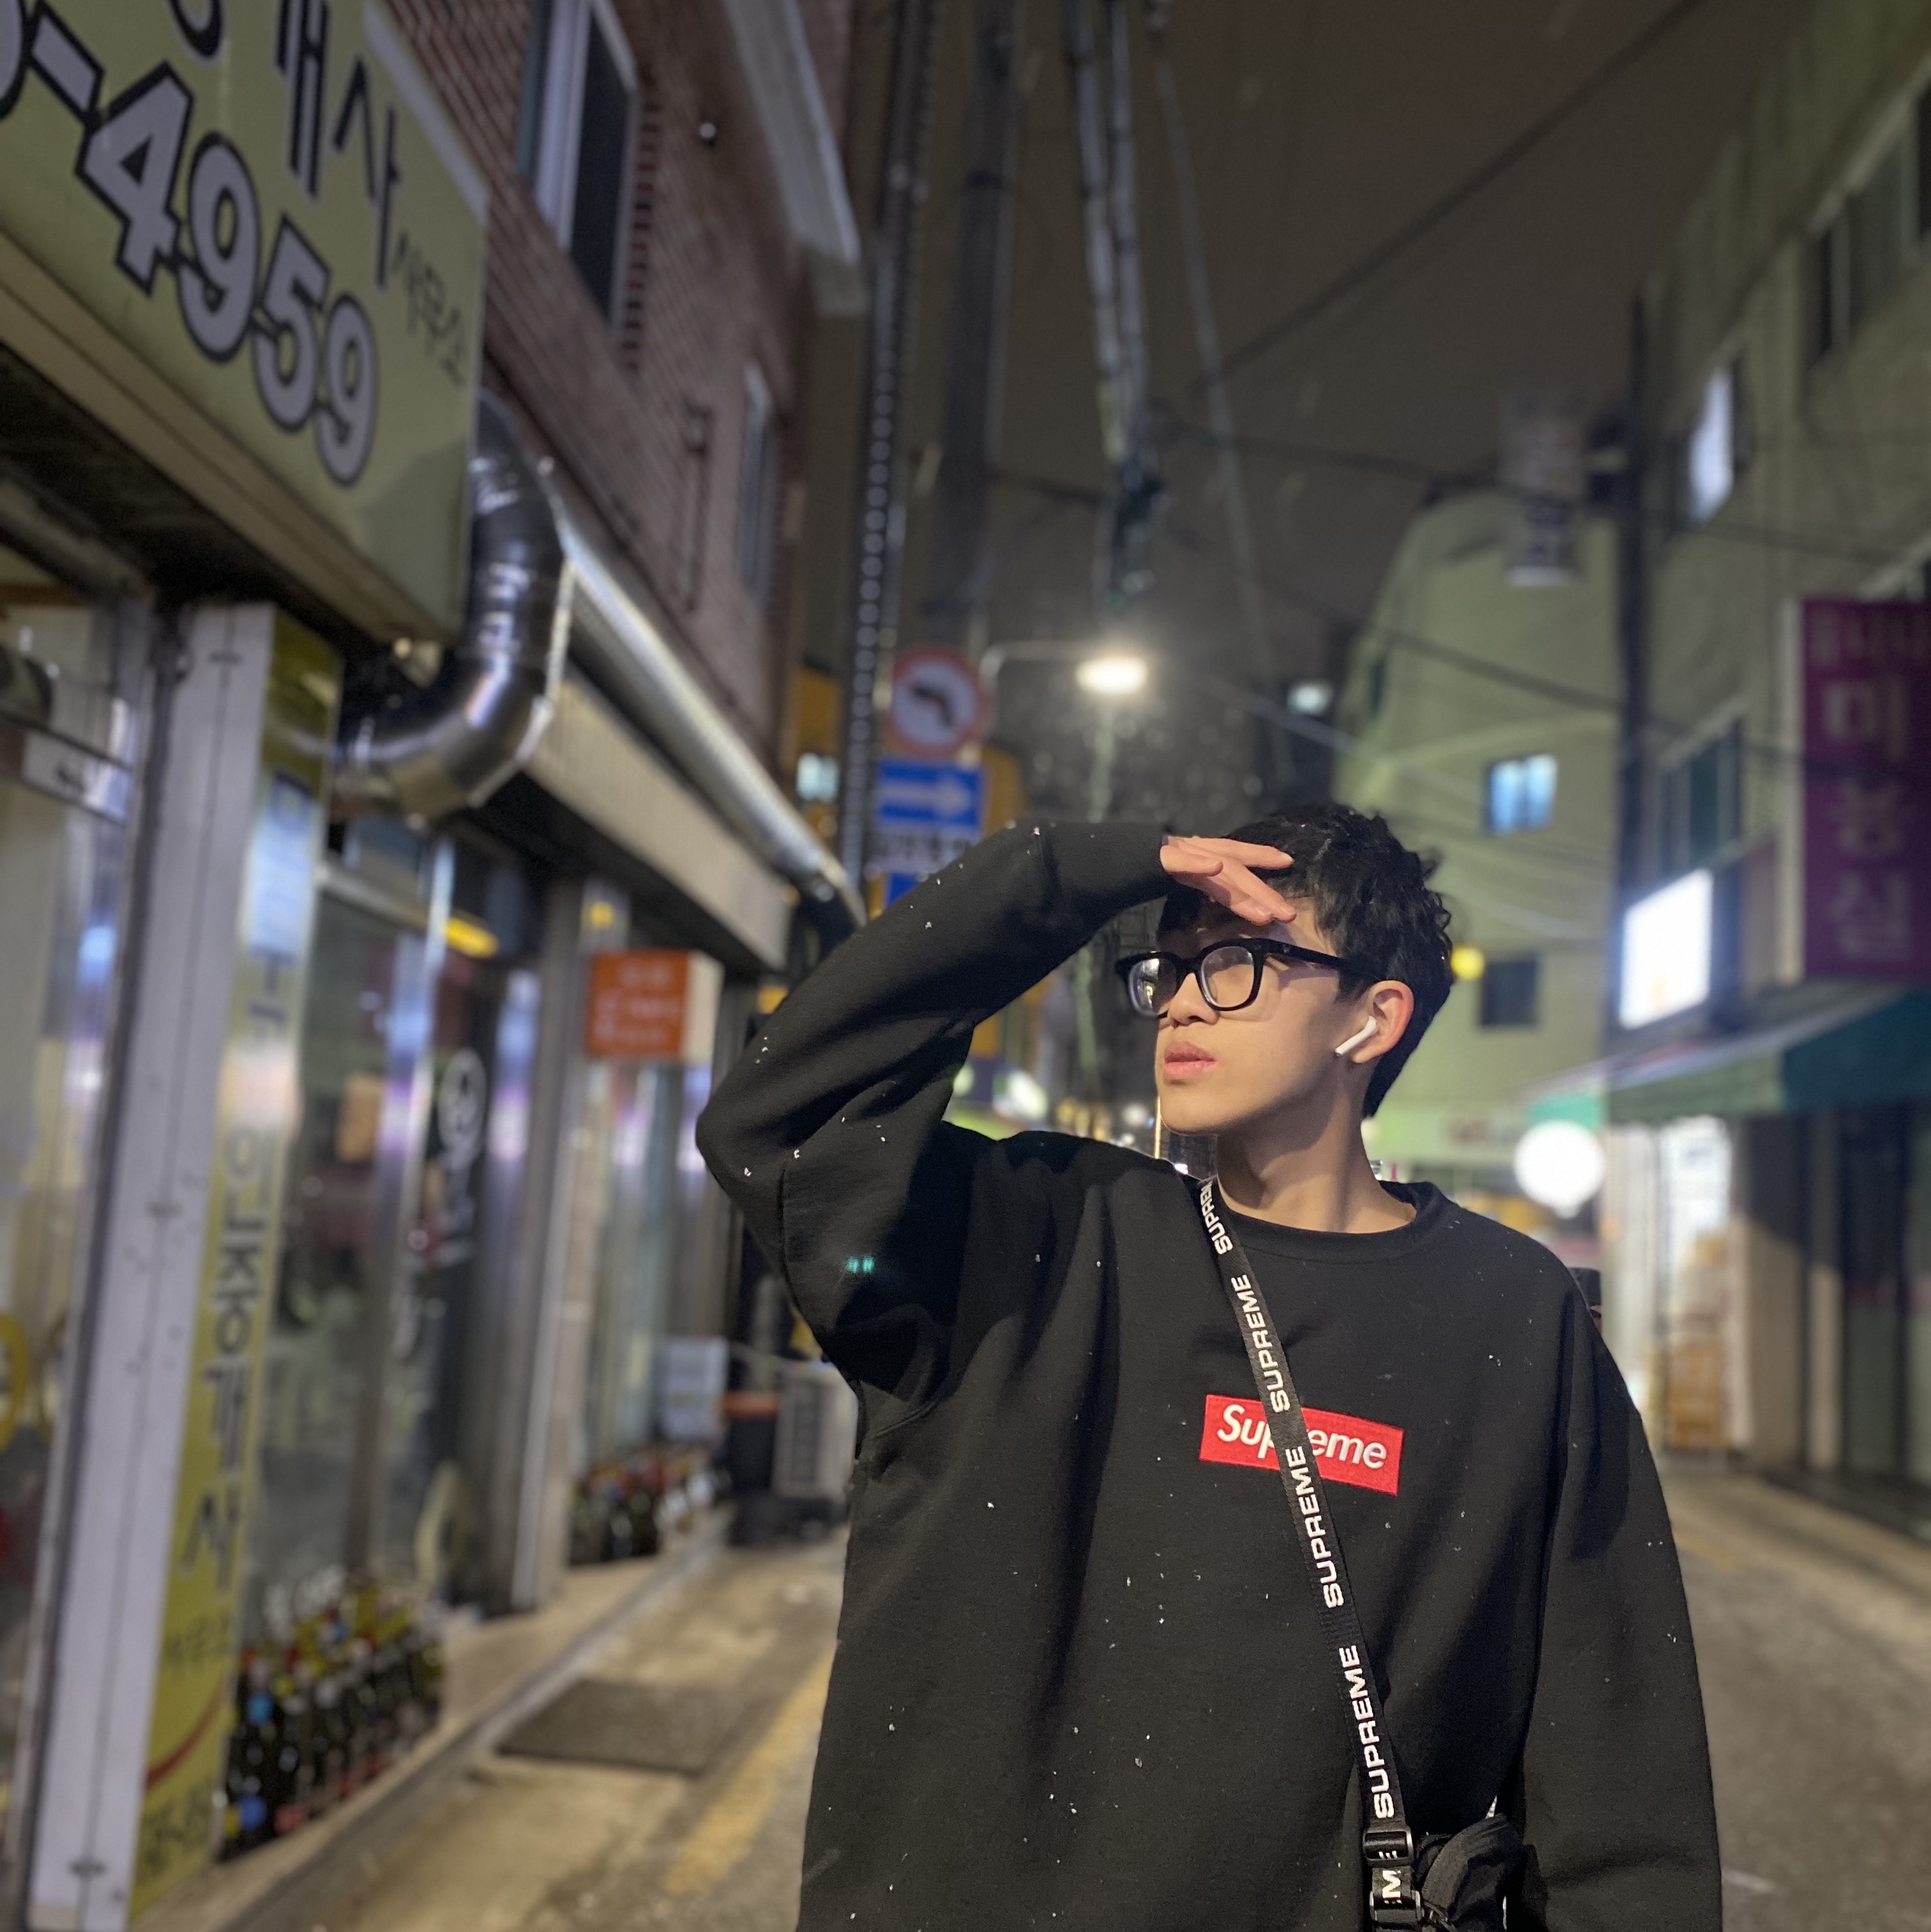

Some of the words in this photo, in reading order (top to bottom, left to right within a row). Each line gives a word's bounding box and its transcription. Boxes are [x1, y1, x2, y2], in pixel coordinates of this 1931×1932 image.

[1231, 1274, 1290, 1413] SUPREME
[1216, 1404, 1388, 1470] Supeme
[1285, 1446, 1344, 1608] SUPREME
[1338, 1645, 1395, 1818] SUPREME
